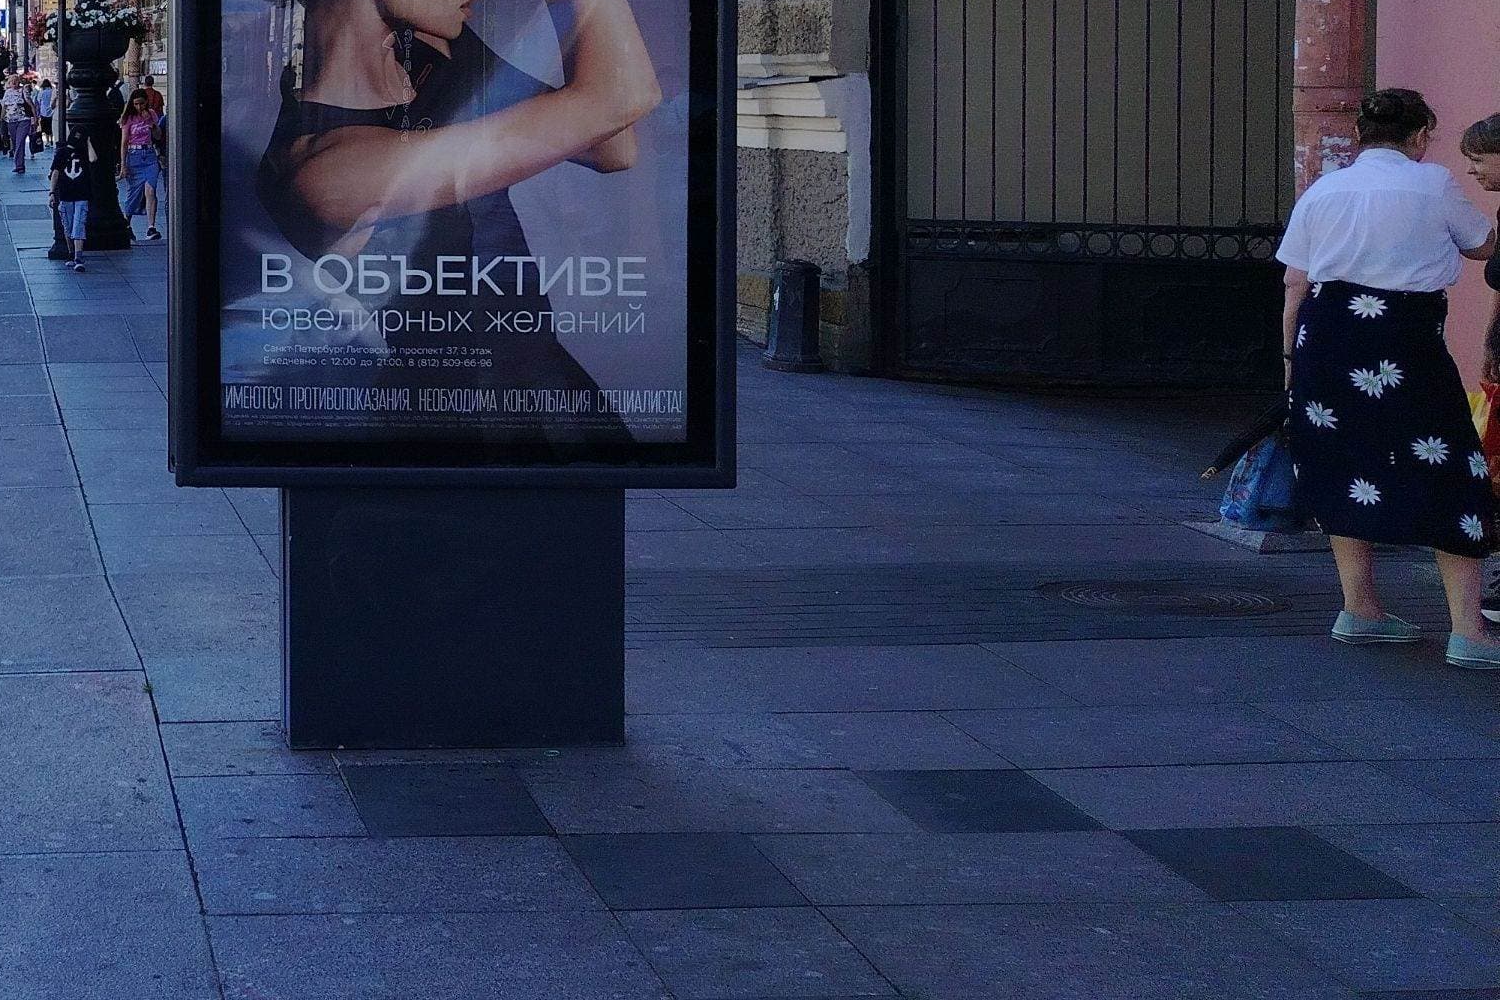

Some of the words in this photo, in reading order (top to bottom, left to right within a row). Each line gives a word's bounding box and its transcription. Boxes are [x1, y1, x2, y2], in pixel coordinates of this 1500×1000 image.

[260, 253, 294, 294] В
[312, 253, 648, 297] ОБЪЕКТИВЕ
[261, 307, 473, 340] ювелирных
[484, 304, 646, 335] желаний
[263, 356, 317, 366] Ежедневно
[331, 357, 357, 366] 12:00
[360, 359, 373, 368] до
[408, 358, 415, 367] 8
[417, 358, 440, 368] (812)
[399, 347, 443, 357] проспект
[225, 385, 283, 410] ИМЕЮТСЯ
[289, 386, 413, 412] ПРОТИВОПОКАЗАНИЯ.
[418, 388, 498, 414] НЕОБХОДИМА
[503, 388, 591, 414] КОНСУЛЬТАЦИЯ
[597, 389, 683, 415] СПЕЦИАЛИСТА!
